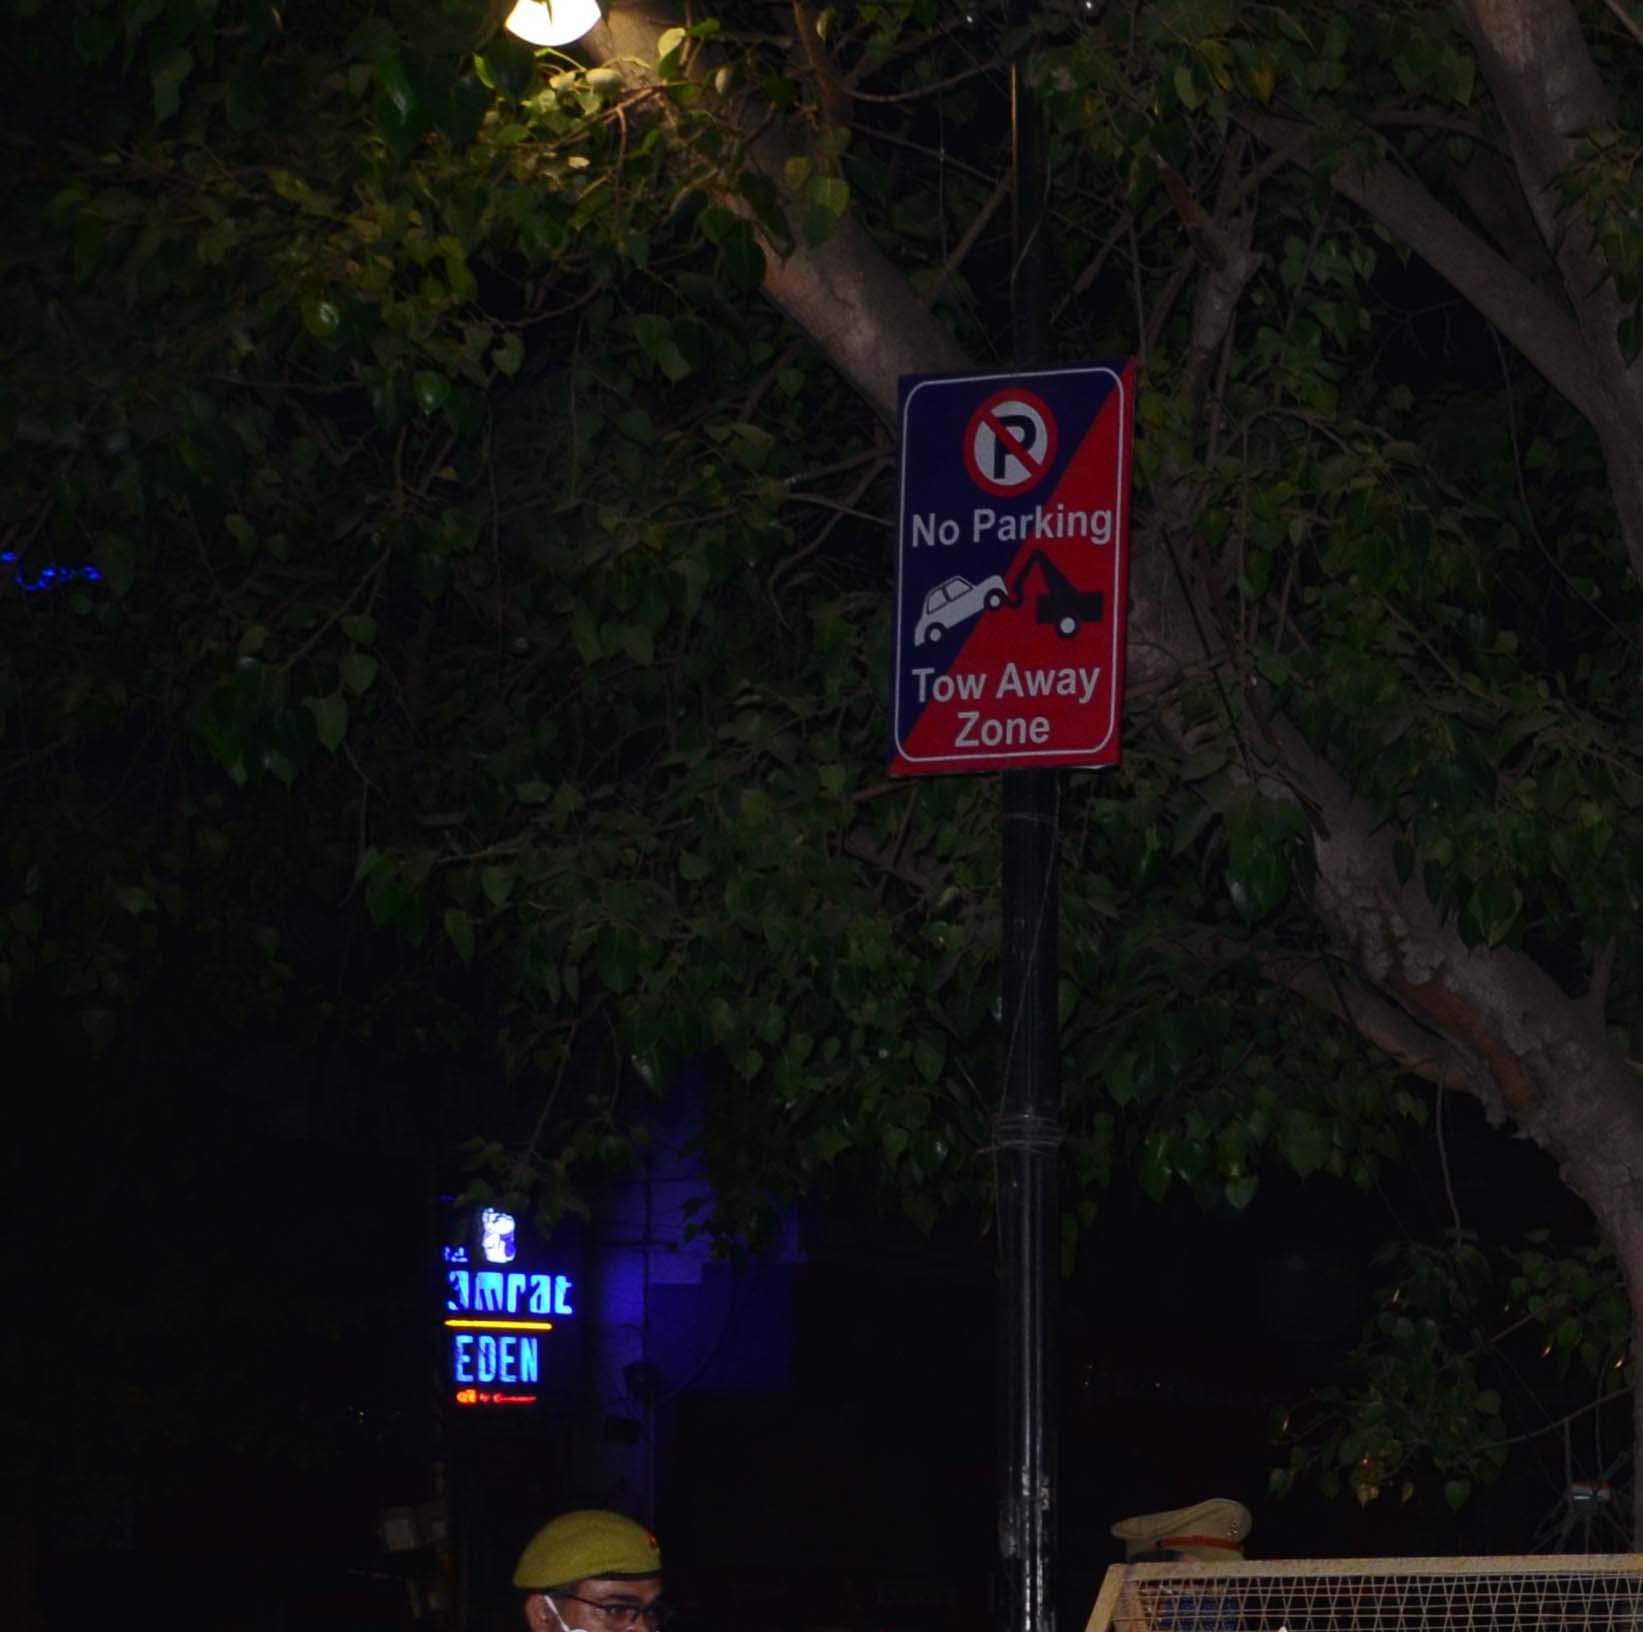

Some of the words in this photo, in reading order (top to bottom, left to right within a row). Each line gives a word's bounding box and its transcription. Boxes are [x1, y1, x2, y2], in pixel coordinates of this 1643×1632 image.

[911, 512, 960, 548] No
[972, 504, 1112, 545] Parking
[911, 667, 987, 704] Tow
[996, 662, 1100, 704] Away
[955, 712, 1051, 748] Zone
[455, 1335, 539, 1383] EDEN
